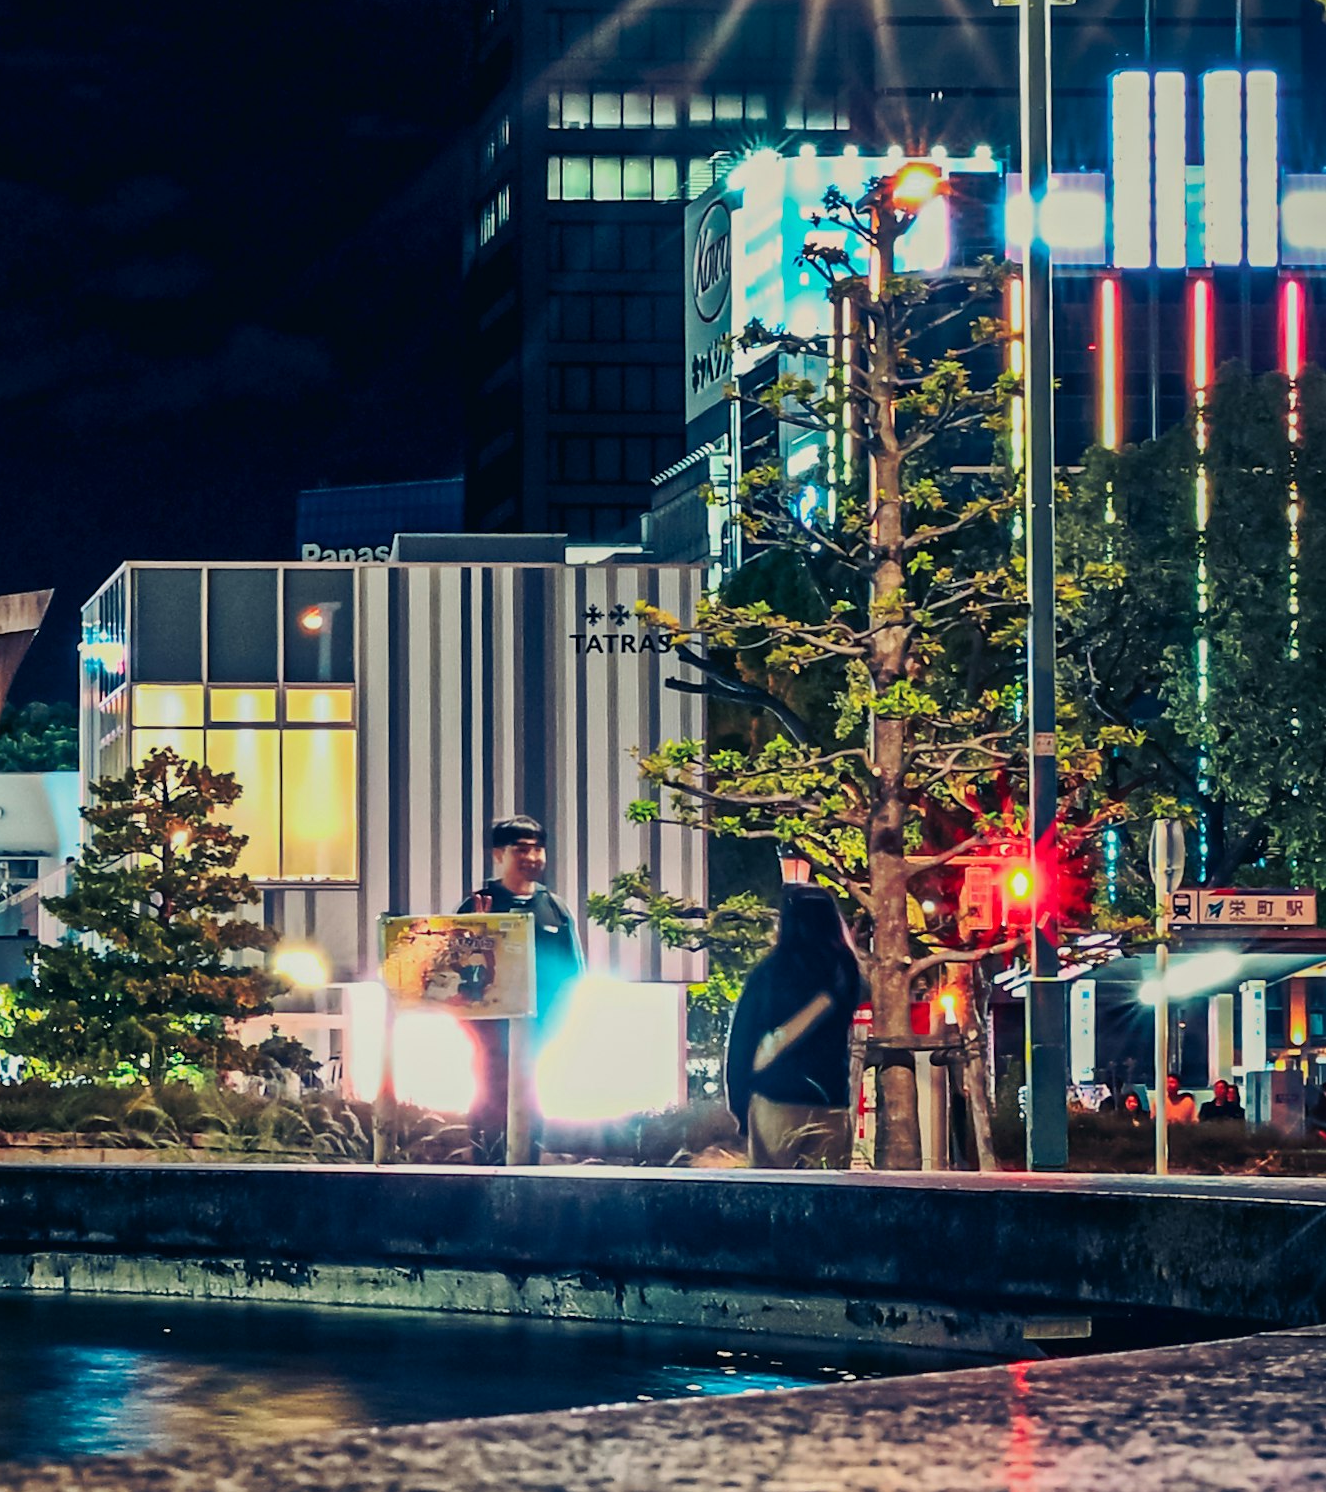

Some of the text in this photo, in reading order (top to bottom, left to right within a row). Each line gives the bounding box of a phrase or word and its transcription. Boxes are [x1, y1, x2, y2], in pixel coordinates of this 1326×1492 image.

[569, 633, 672, 654] TATRAS
[1229, 899, 1303, 917] 栄町駅
